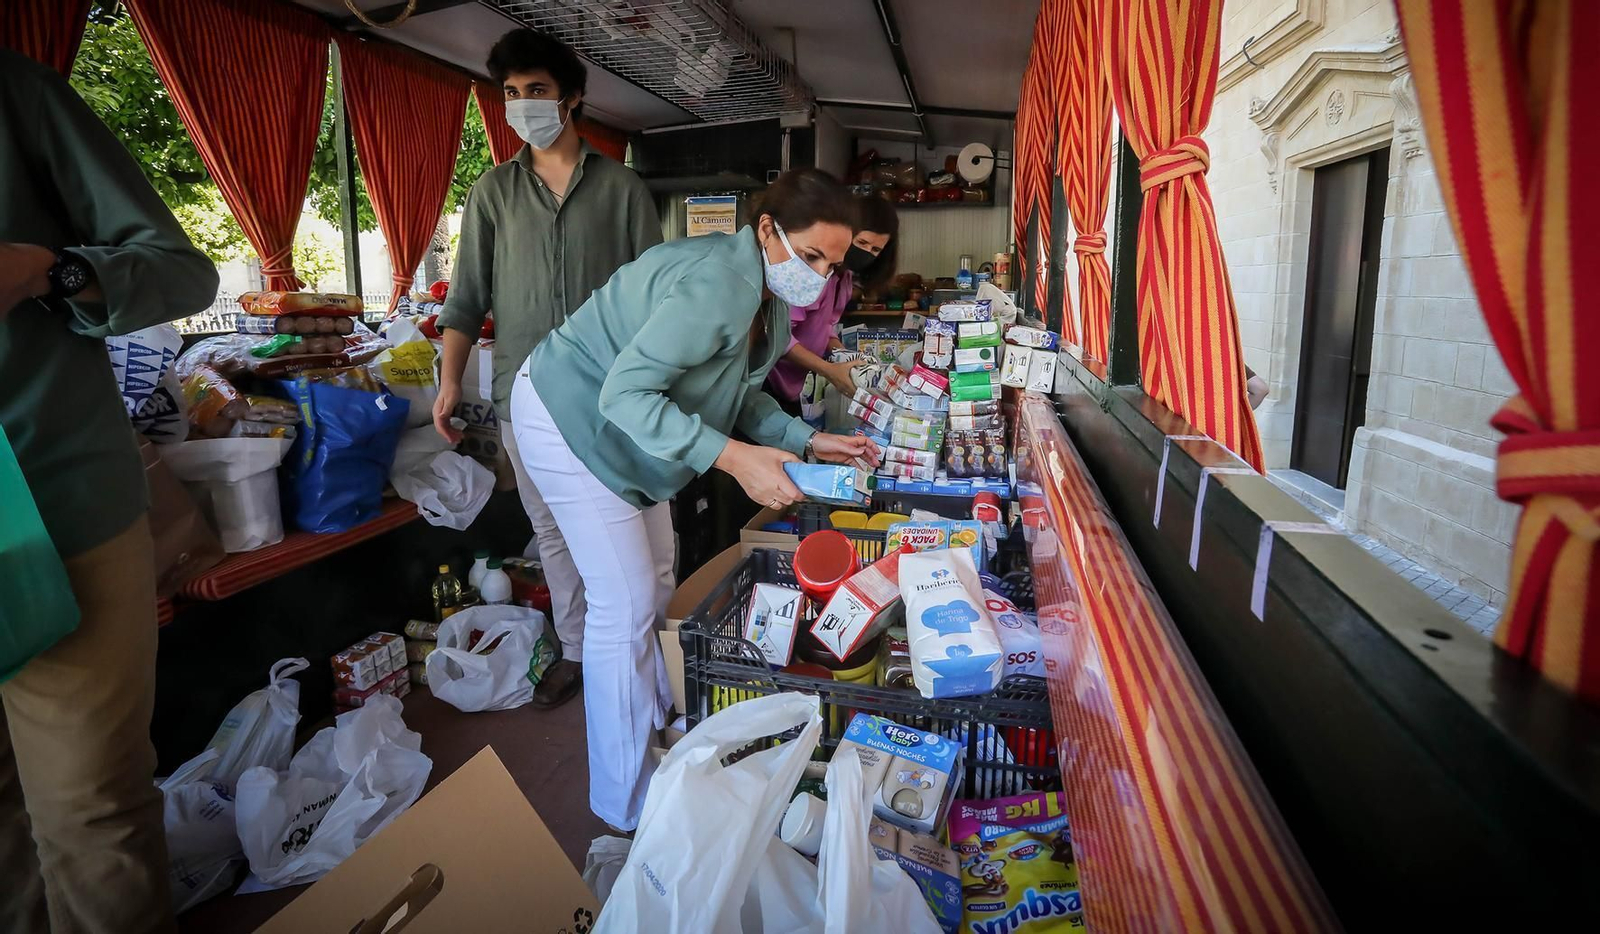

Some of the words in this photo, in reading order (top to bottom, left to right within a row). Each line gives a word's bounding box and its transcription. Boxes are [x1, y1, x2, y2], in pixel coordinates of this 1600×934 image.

[691, 216, 700, 224] Al
[701, 216, 732, 224] Camino
[901, 535, 909, 545] 6
[910, 536, 936, 544] PACK
[936, 608, 964, 618] Harina
[935, 617, 946, 625] de
[948, 614, 969, 624] Trigo
[1007, 651, 1037, 665] SOS
[885, 726, 920, 743] Hero
[890, 736, 913, 747] Baby
[866, 738, 896, 752] BUENAS
[896, 747, 927, 762] NOCHES
[1005, 799, 1040, 819] KG
[1045, 792, 1062, 817] 1
[899, 857, 933, 876] BUENAS
